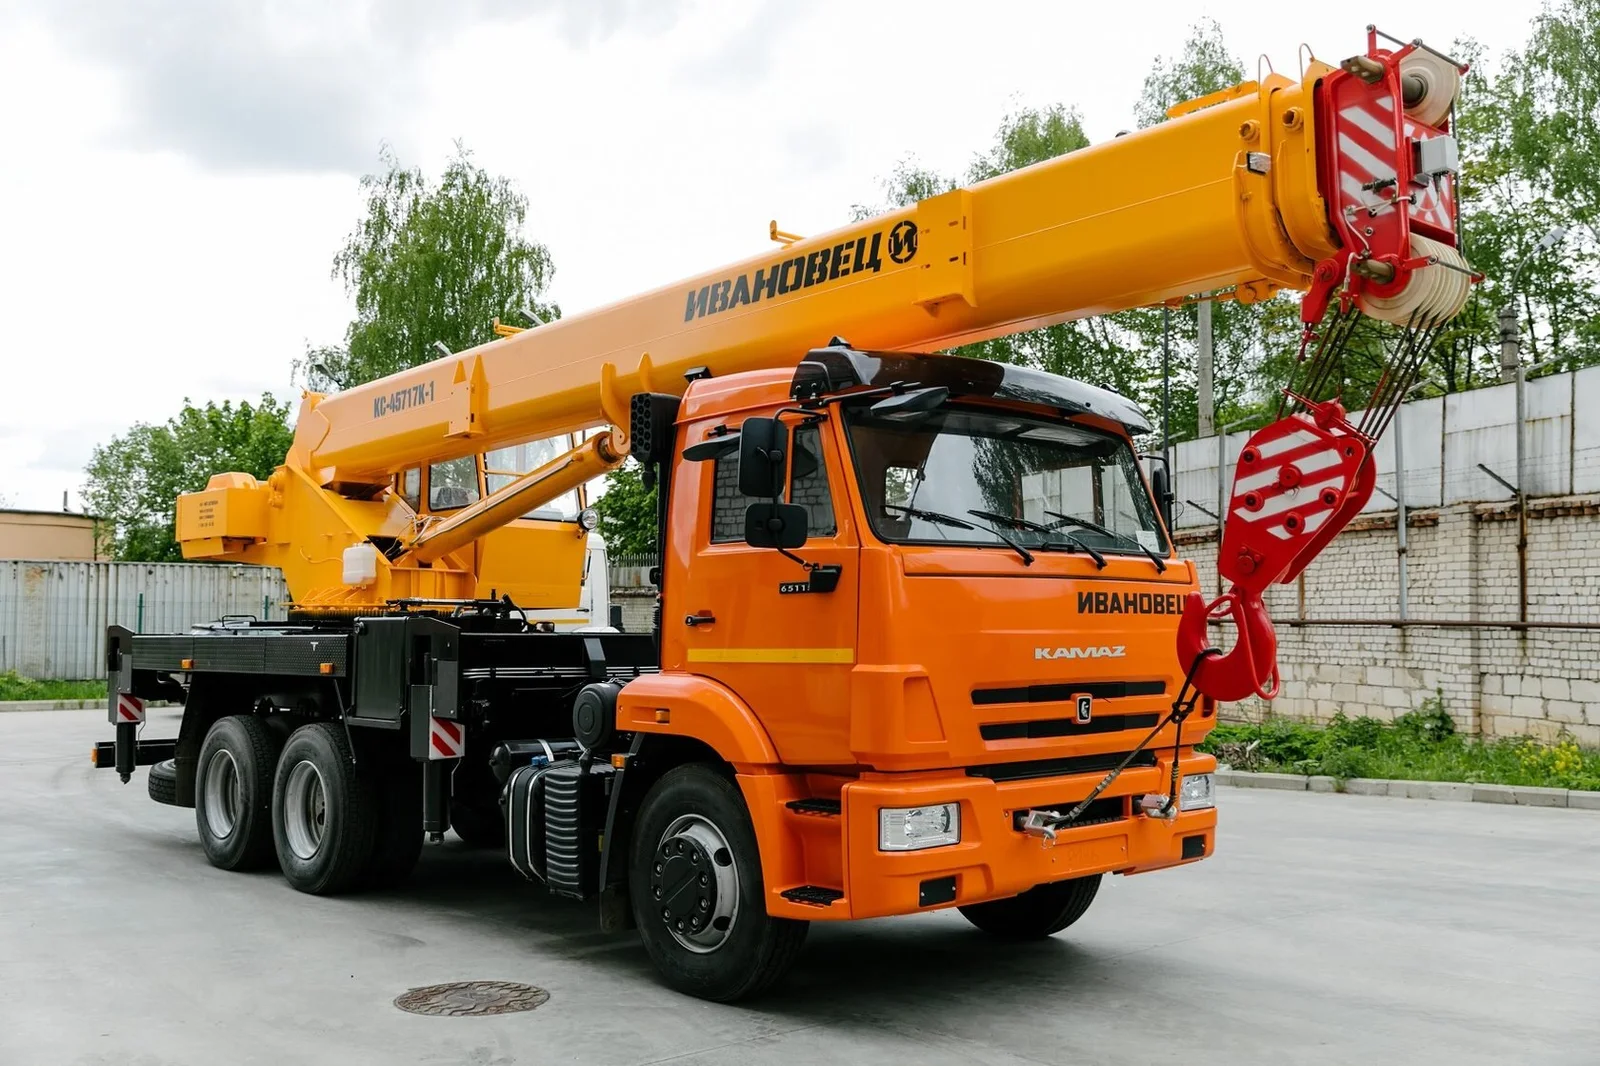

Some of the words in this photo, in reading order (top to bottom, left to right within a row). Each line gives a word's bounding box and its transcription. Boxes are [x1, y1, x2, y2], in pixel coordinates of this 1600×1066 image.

[684, 231, 883, 322] ИВАНОВЕЦ
[373, 380, 434, 418] КС-45717К-1
[1034, 645, 1126, 660] KAMAZ
